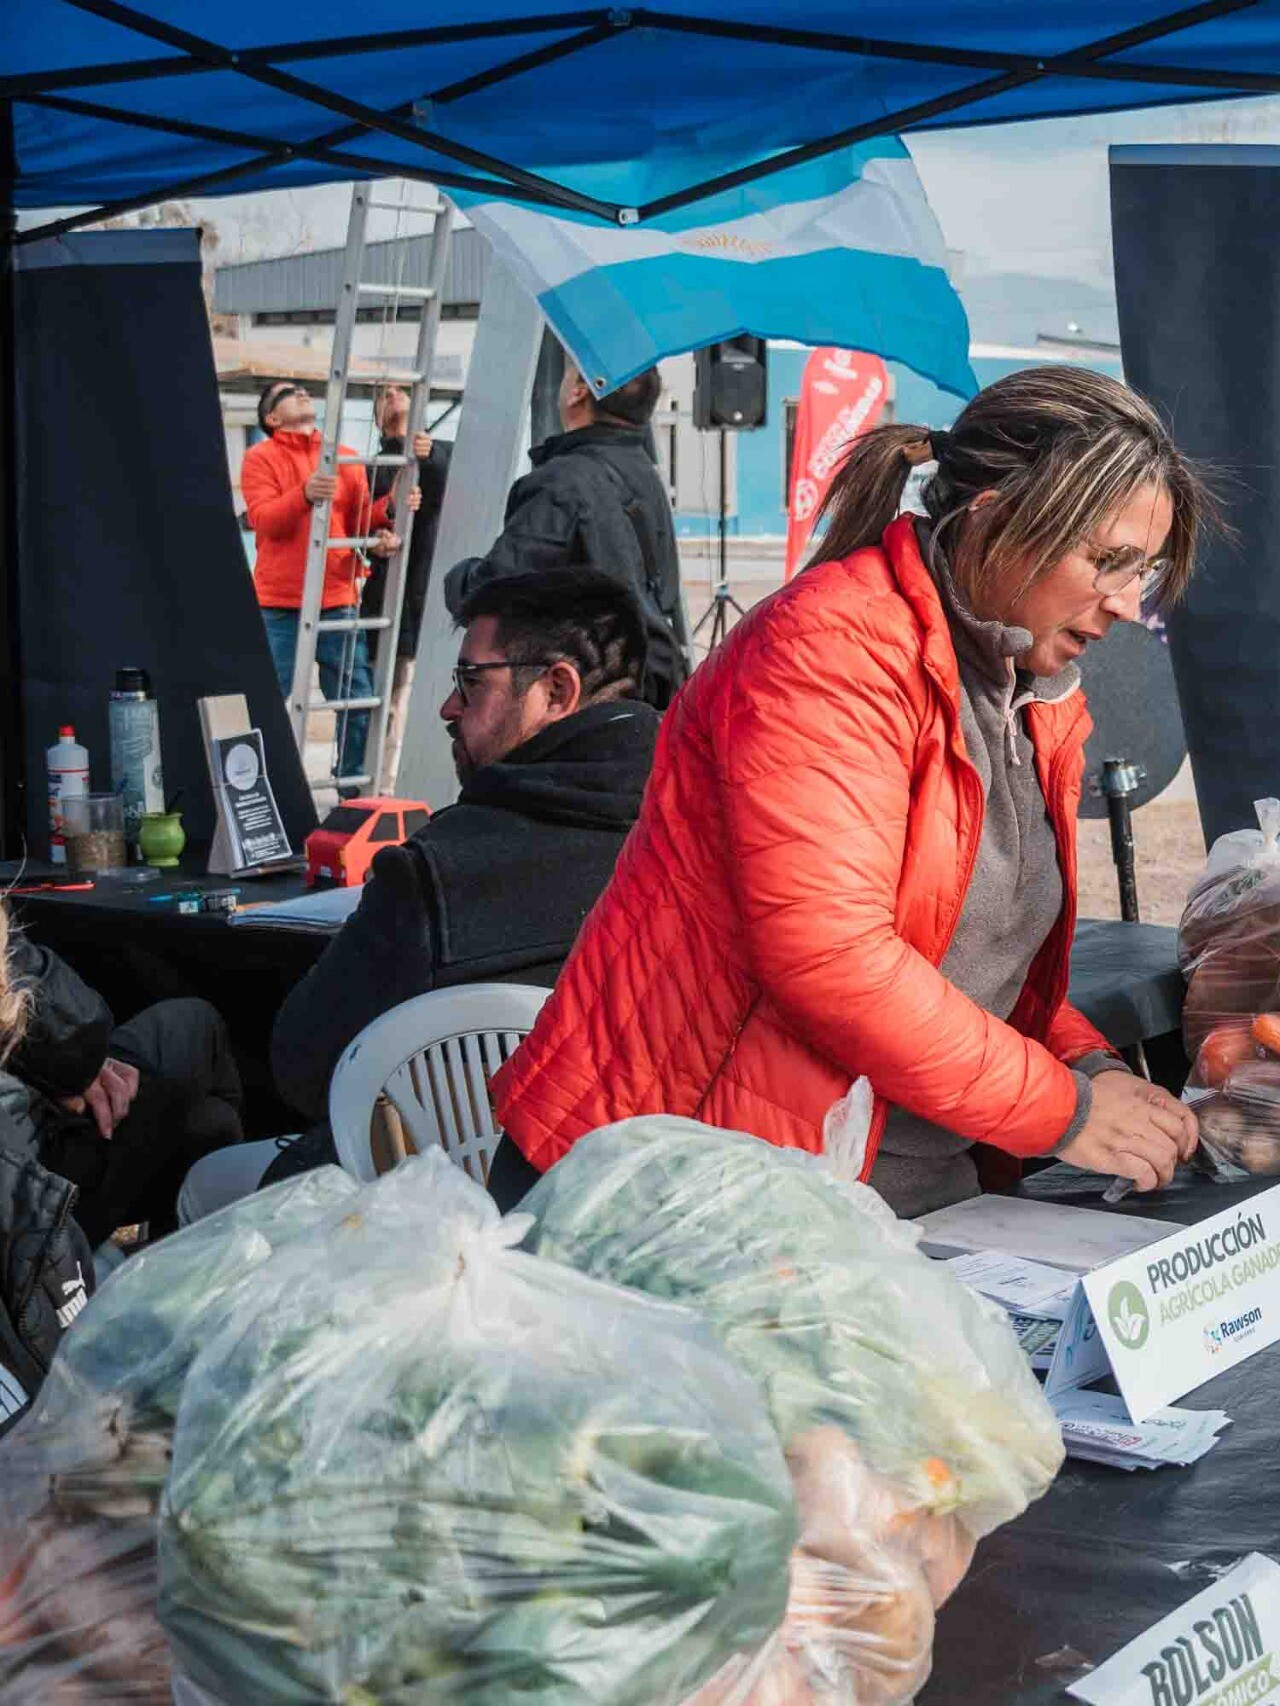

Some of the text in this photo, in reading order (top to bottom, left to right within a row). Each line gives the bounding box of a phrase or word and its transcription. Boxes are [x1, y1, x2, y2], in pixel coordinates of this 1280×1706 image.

[1147, 1212, 1266, 1294] PRODUCCIÓN
[1160, 1274, 1232, 1327] AGRÍCOLA
[1220, 1306, 1262, 1338] Rawson
[1140, 1592, 1264, 1706] BOLSON
